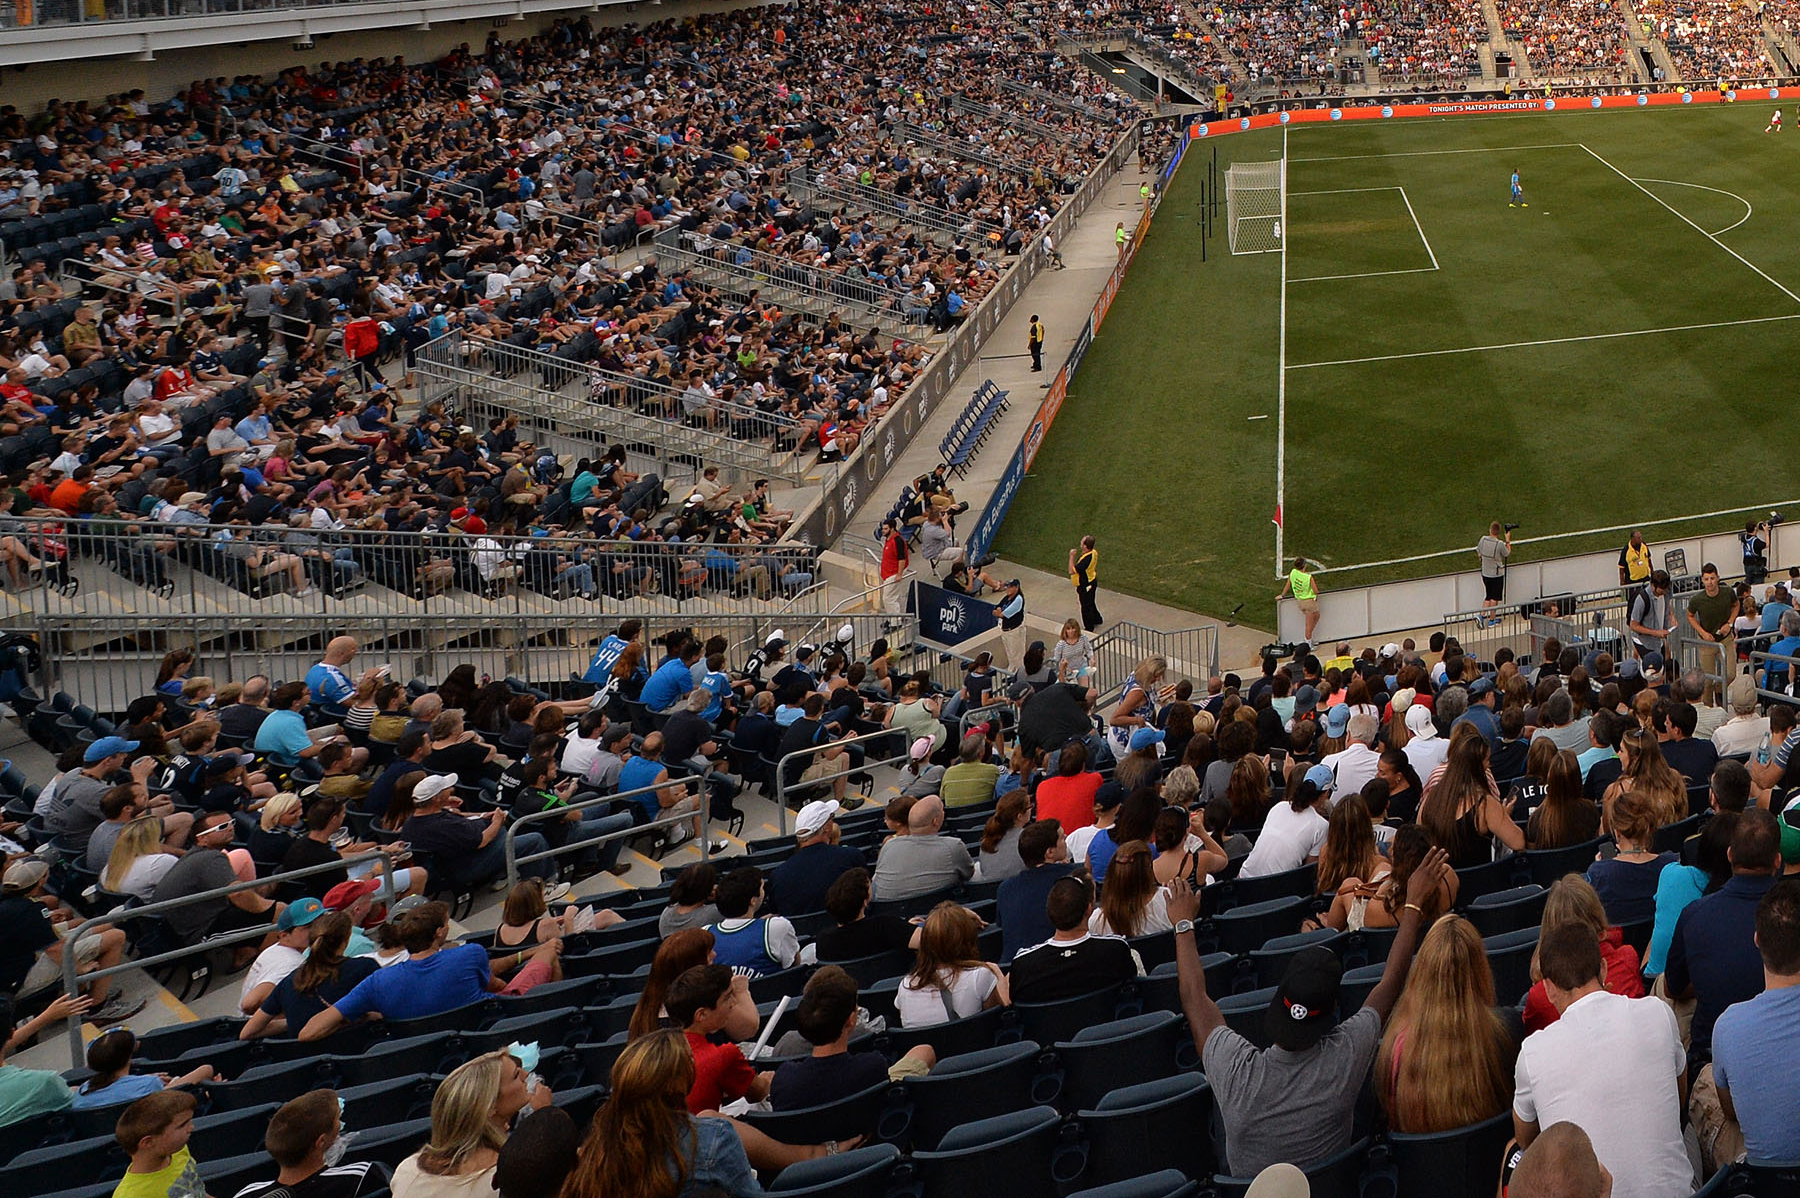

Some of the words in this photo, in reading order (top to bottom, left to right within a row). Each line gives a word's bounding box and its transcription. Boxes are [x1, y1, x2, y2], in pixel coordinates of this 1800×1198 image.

[1429, 105, 1464, 113] TONIGHT'S
[940, 607, 956, 623] ppl
[942, 622, 958, 634] park
[595, 648, 621, 671] 44
[747, 659, 758, 673] 9
[1522, 785, 1535, 799] LE
